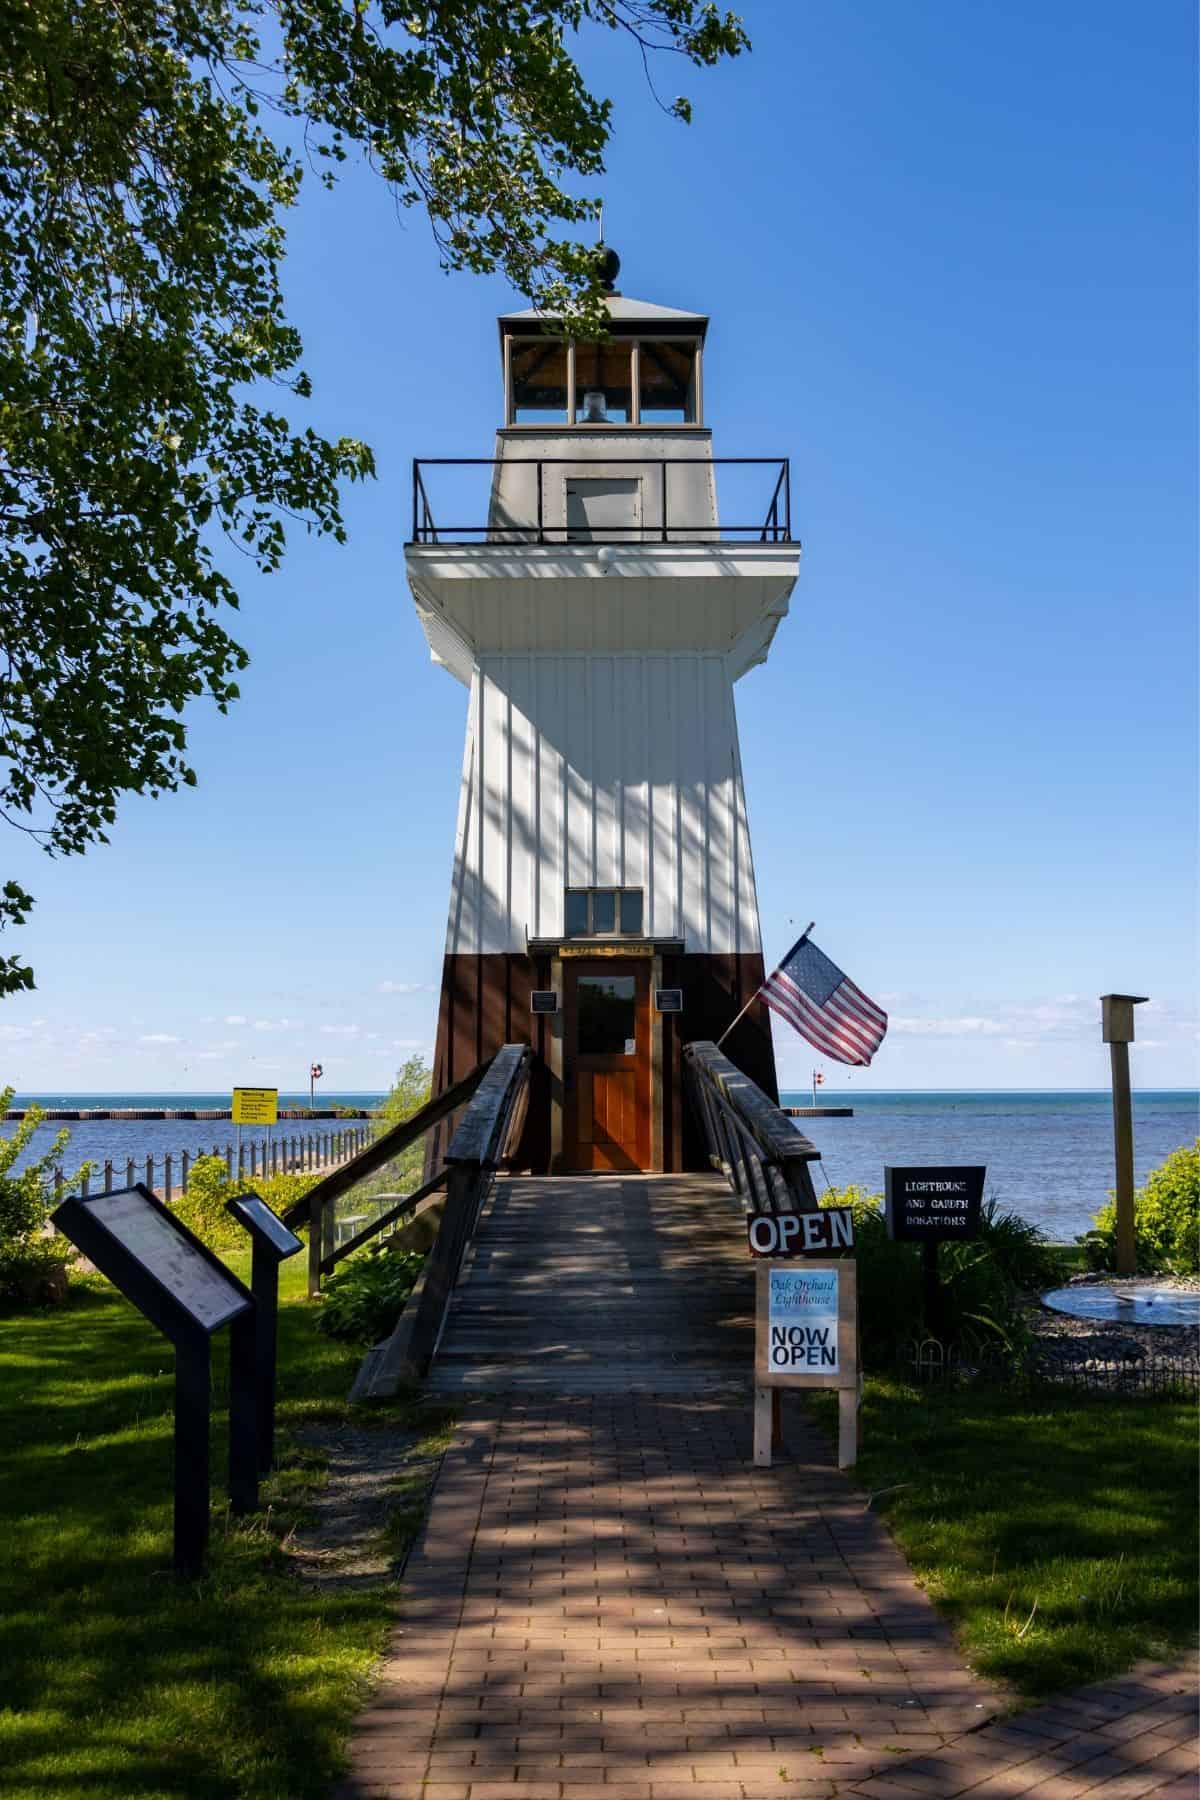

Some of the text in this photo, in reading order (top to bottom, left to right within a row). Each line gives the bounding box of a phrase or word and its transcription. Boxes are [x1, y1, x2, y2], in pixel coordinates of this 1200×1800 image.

[905, 1182, 967, 1192] LIGHTHOUSE
[905, 1199, 969, 1209] AND GARDEN
[906, 1216, 966, 1226] DONATIONS
[750, 1210, 854, 1253] OPEN
[771, 1278, 835, 1292] Oak Orchard
[771, 1326, 829, 1346] NOW
[772, 1346, 836, 1366] OPEN
